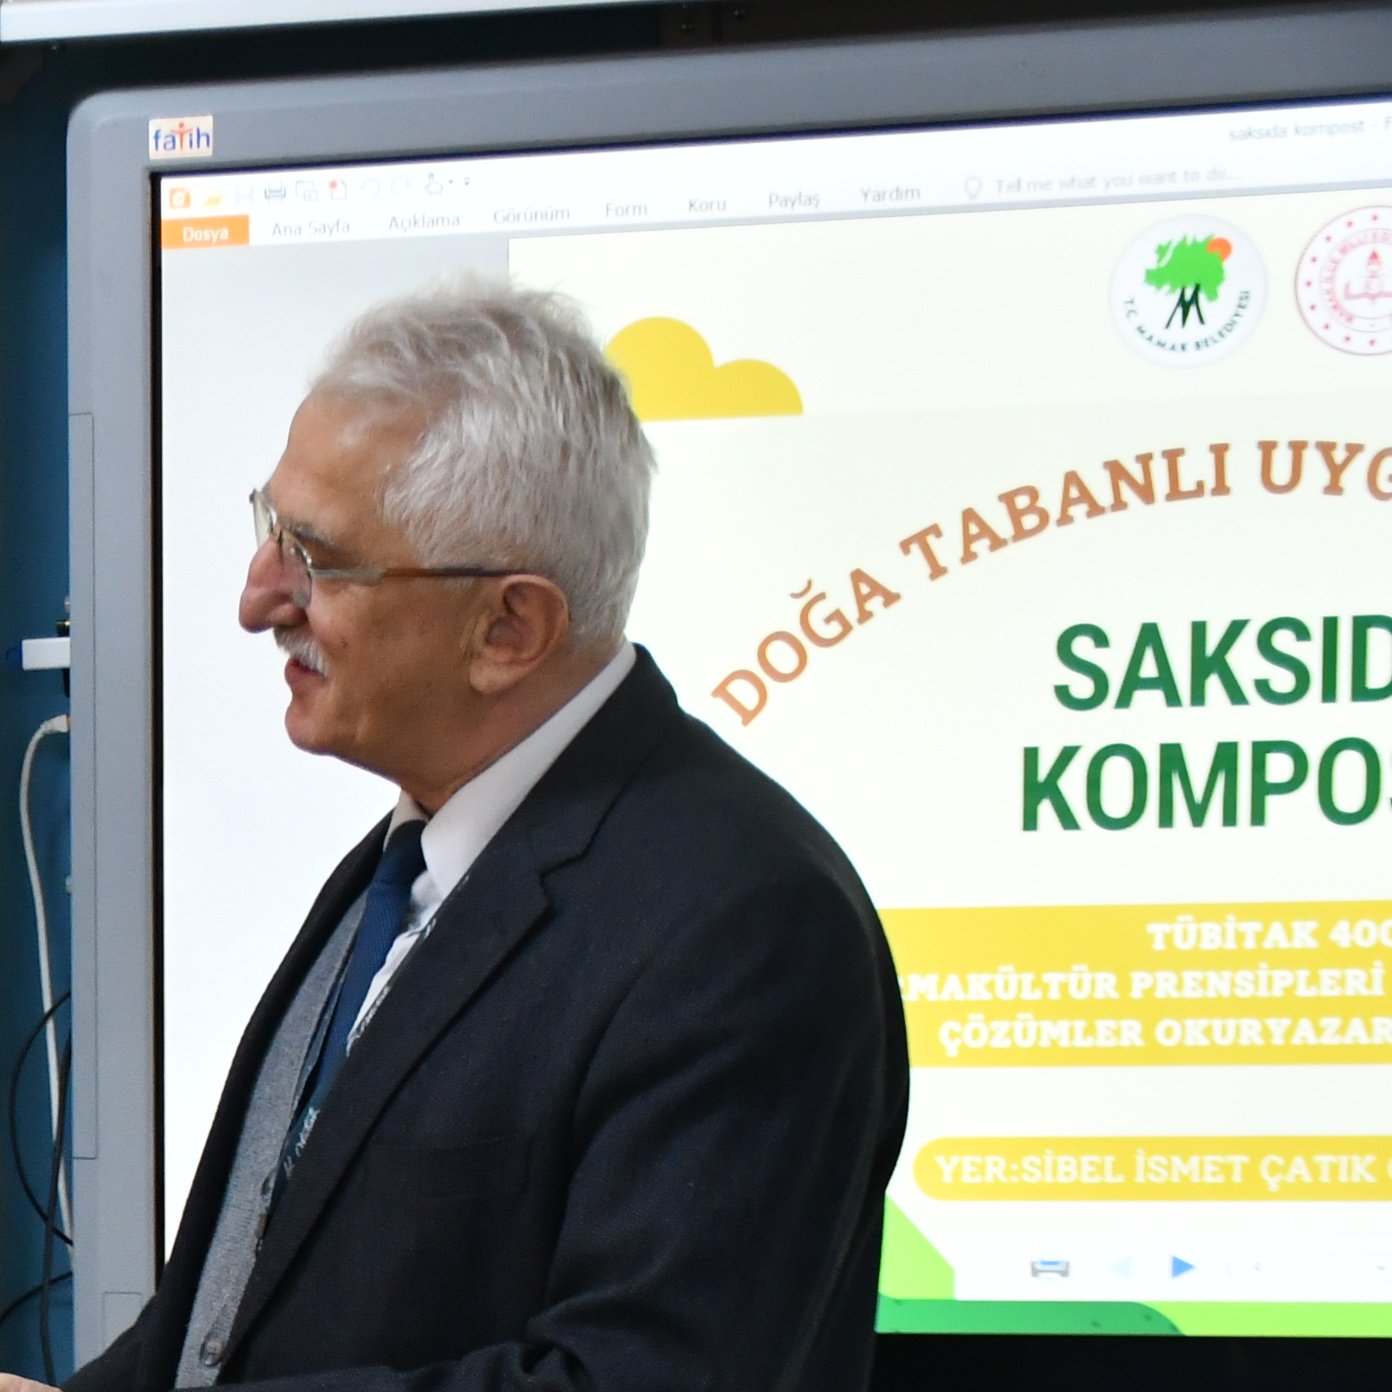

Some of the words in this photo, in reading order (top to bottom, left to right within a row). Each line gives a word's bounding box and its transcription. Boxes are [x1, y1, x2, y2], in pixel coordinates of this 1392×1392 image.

[153, 122, 211, 151] fatih
[995, 177, 1022, 194] Tell
[1027, 180, 1052, 192] me
[1059, 174, 1096, 190] what
[1138, 170, 1177, 186] want
[183, 227, 229, 246] Dosya
[272, 222, 302, 237] Ana
[309, 219, 351, 238] Sayfa
[388, 213, 460, 232] Açıklama
[493, 205, 571, 225] Görünüm
[605, 202, 648, 218] Form
[688, 198, 727, 214] Koru
[769, 191, 820, 210] Paylaş
[860, 185, 921, 203] Yardım
[1136, 324, 1189, 352] MAMAK
[711, 568, 902, 727] DOĞA
[899, 442, 1232, 582] TABANLI
[1257, 440, 1392, 501] UYG
[1053, 614, 1392, 712] SAKSID
[1021, 737, 1392, 832] KOMPO
[1146, 914, 1320, 950] TÜBİTAK
[1130, 959, 1385, 999] PRENSİPLERİ
[939, 1012, 1144, 1056] ÇÖZÜMLER
[1155, 1015, 1392, 1048] OKURYAZAR
[934, 1147, 1125, 1185] YER:SİBEL
[1135, 1147, 1250, 1184] İSMET
[1259, 1153, 1378, 1192] ÇATIK
